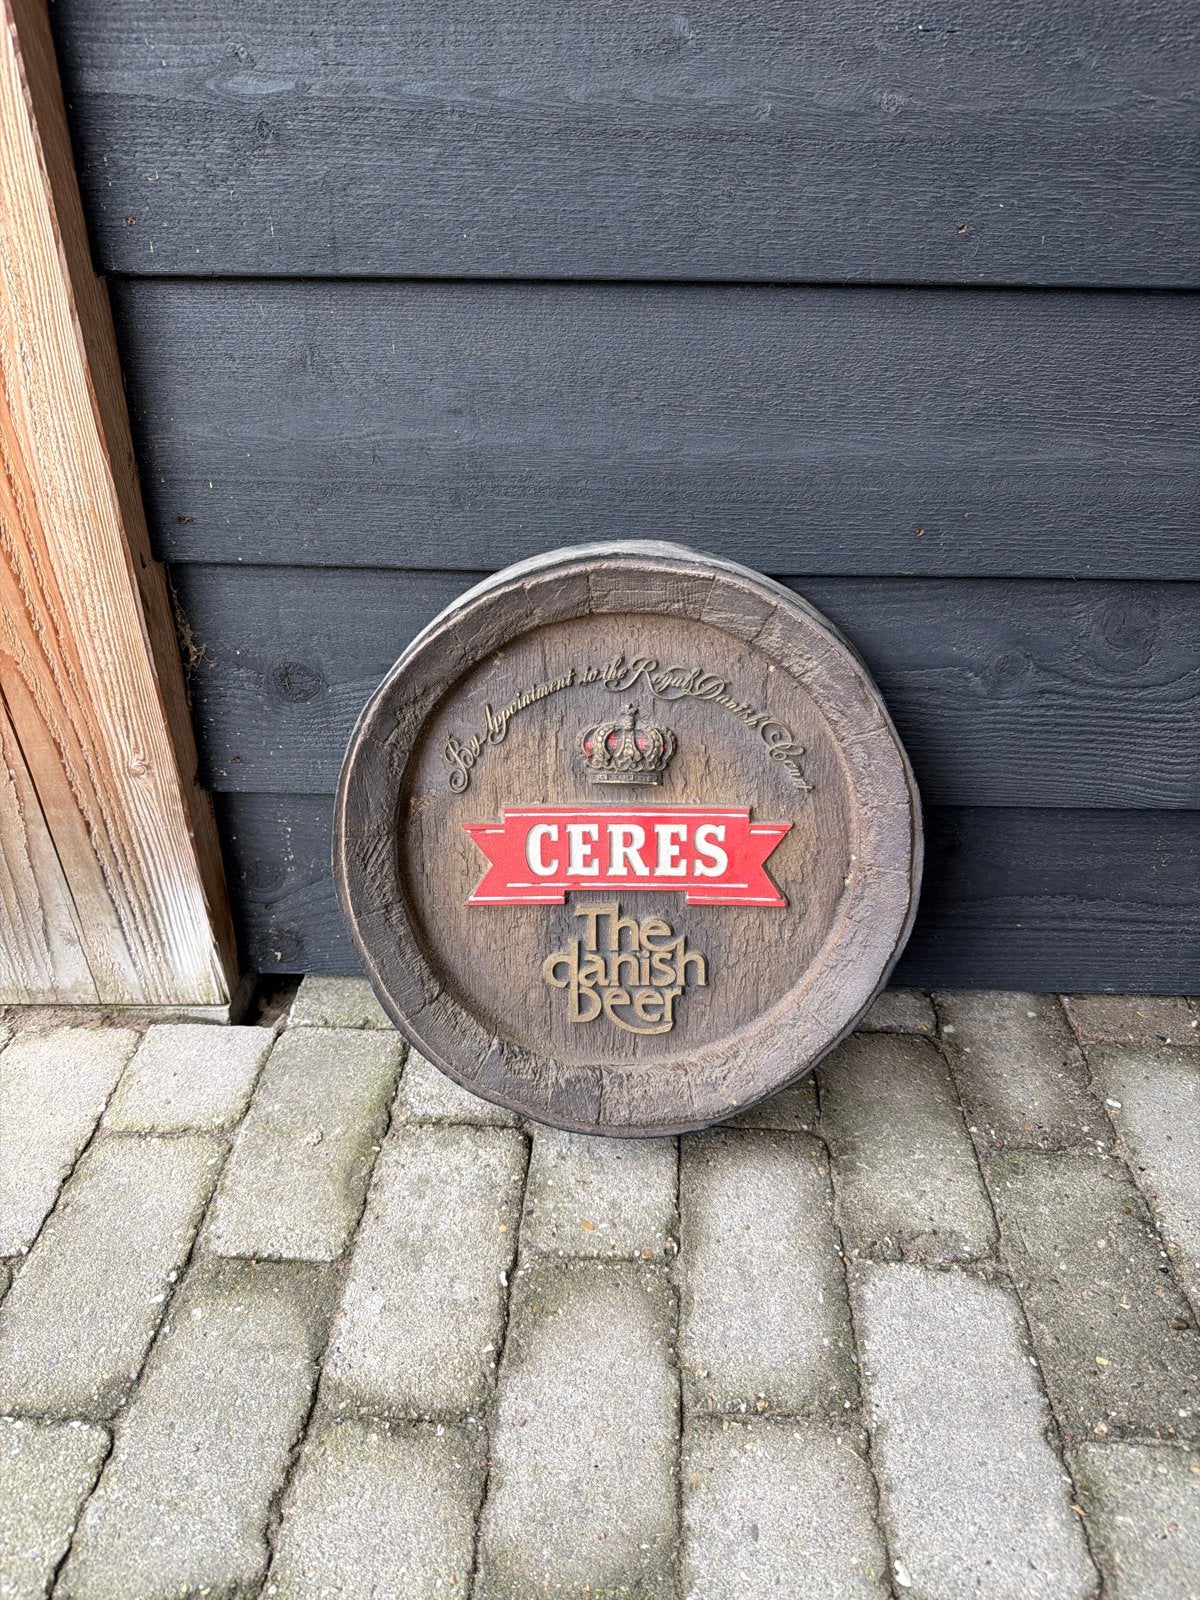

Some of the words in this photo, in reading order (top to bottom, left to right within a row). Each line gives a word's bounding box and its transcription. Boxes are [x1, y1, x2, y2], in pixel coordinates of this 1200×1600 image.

[581, 667, 600, 685] to
[601, 654, 628, 680] the
[604, 657, 703, 700] Royal
[481, 669, 575, 744] Appointment
[688, 673, 770, 728] Danish
[445, 734, 482, 793] By
[760, 720, 814, 791] Court
[525, 823, 729, 877] CERES
[574, 905, 685, 952] The
[544, 937, 708, 988] danish
